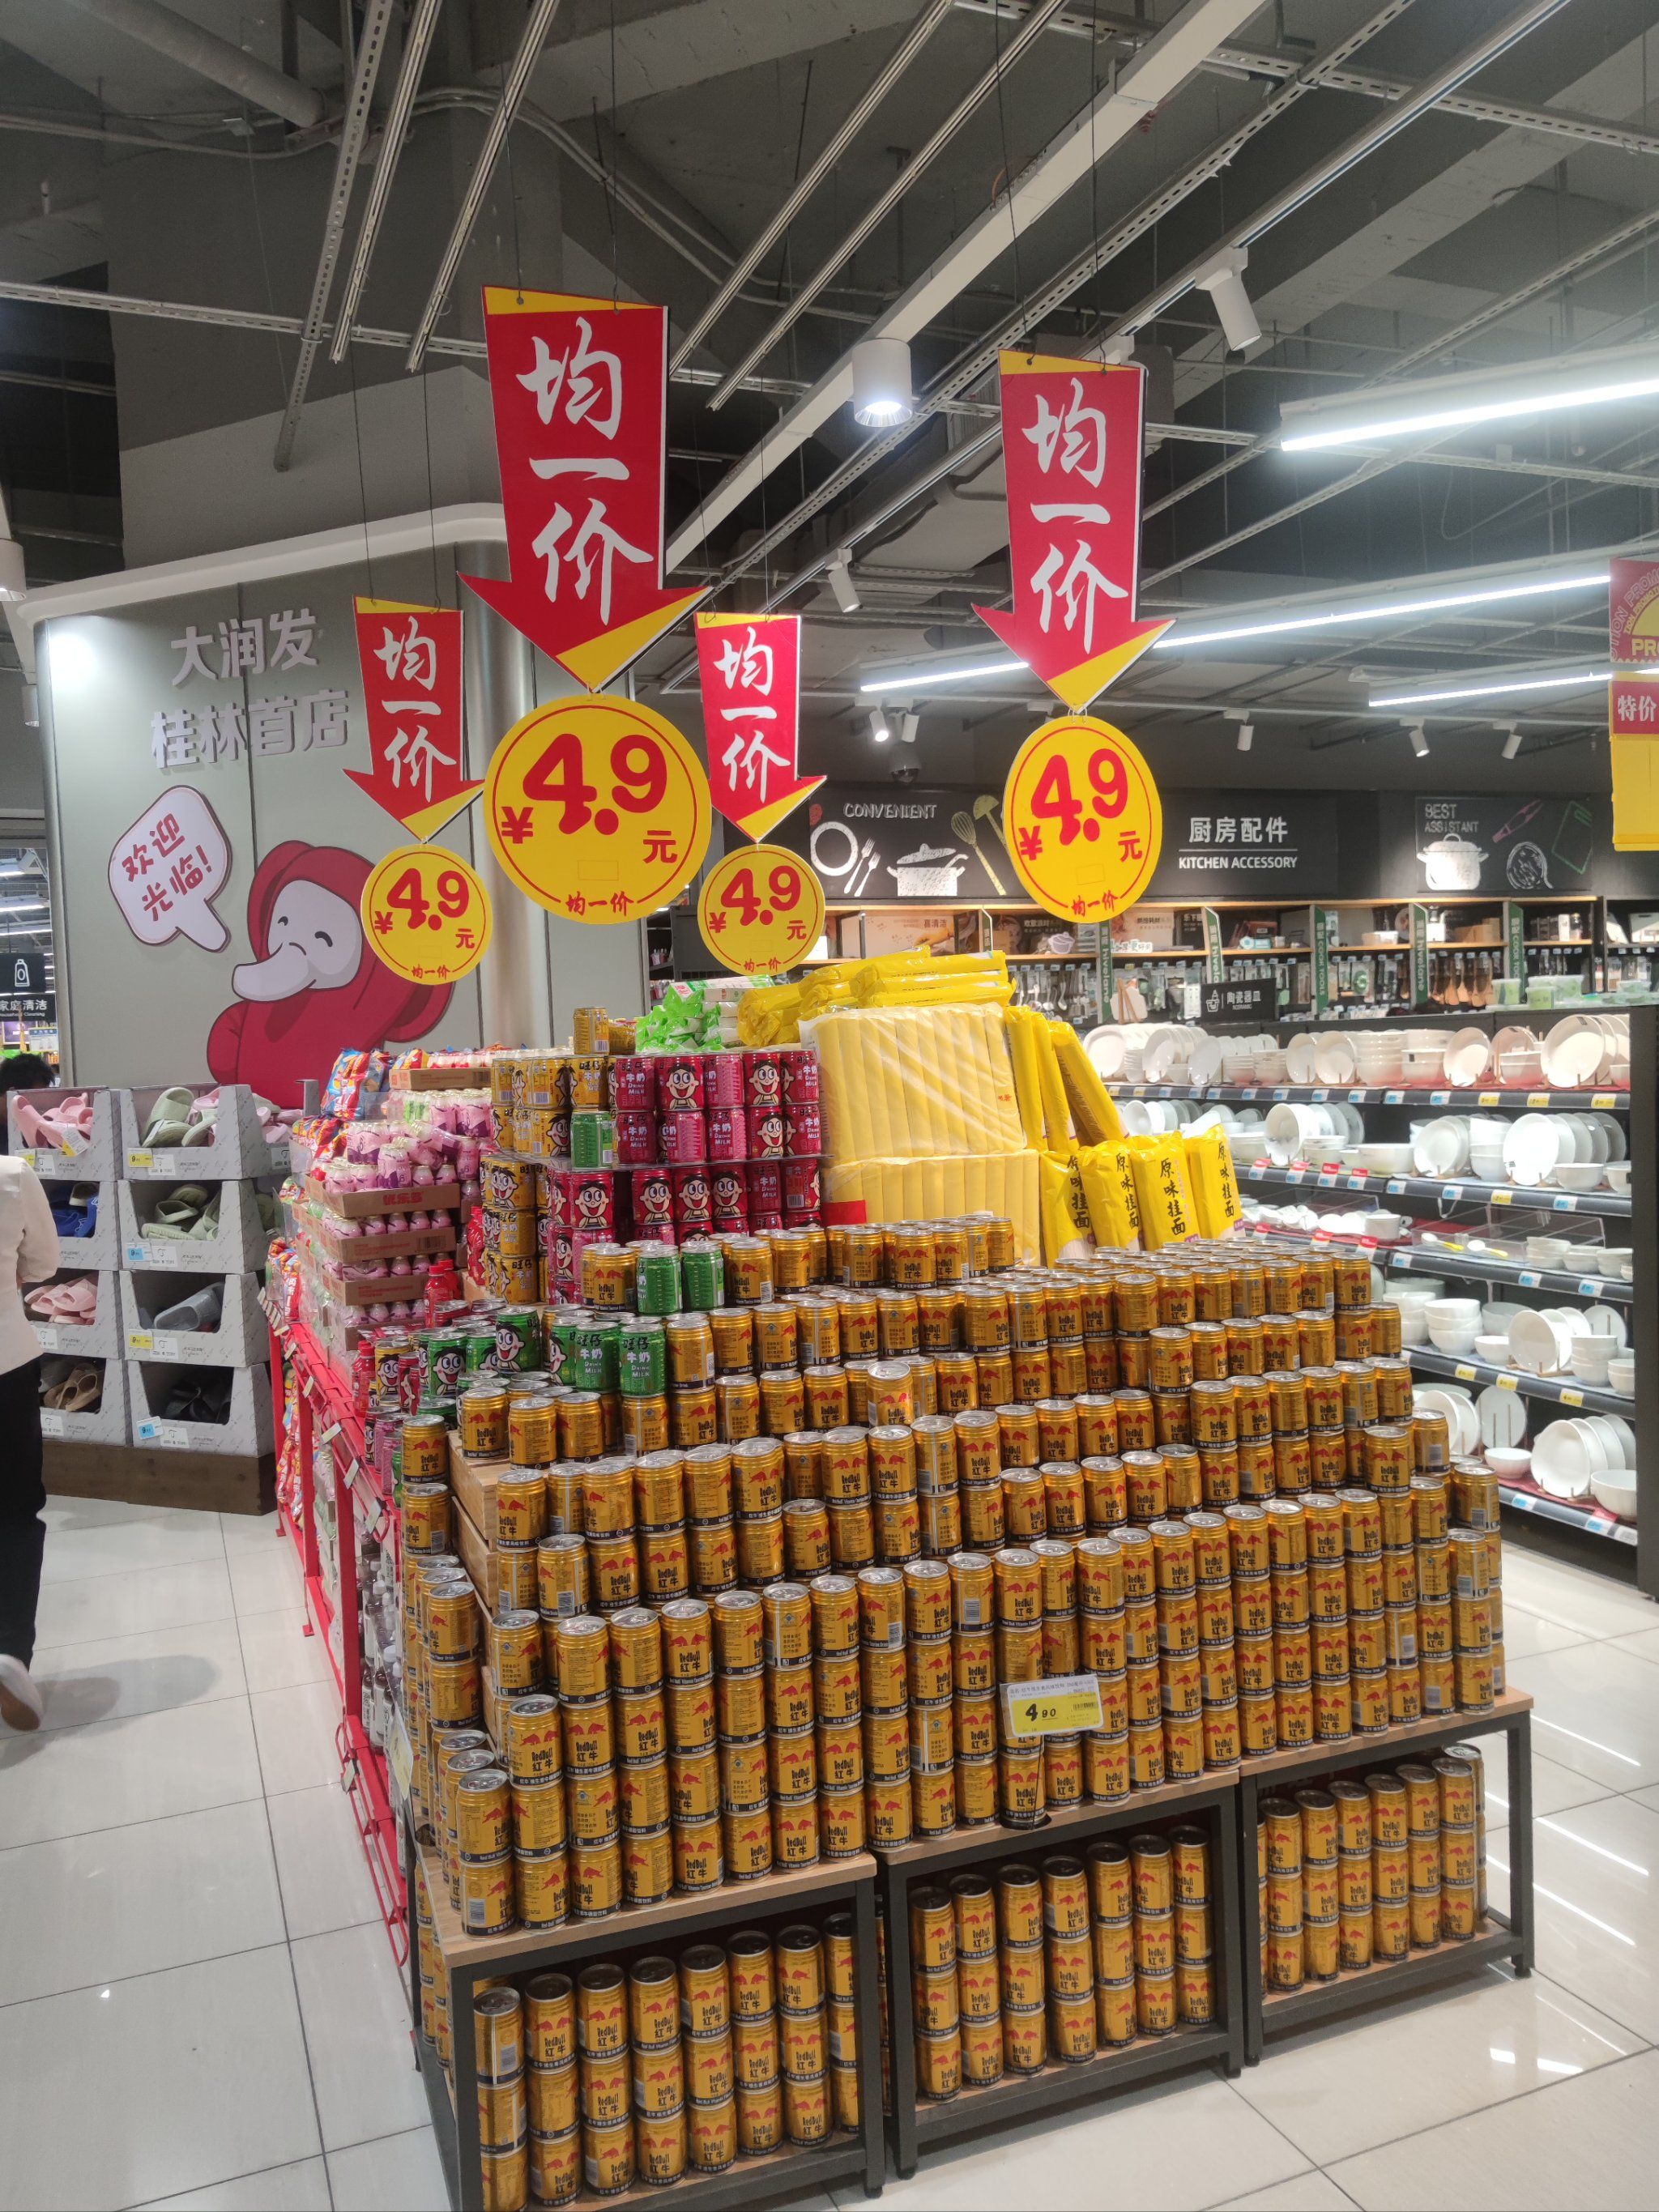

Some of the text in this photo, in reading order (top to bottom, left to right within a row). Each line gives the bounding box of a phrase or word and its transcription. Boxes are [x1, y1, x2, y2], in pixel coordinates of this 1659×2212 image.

[515, 316, 654, 626] 均一价
[1021, 377, 1128, 654] 均一价
[170, 607, 318, 686] 大润发
[1631, 638, 1659, 657] PR
[373, 616, 457, 803] 均一价
[1617, 694, 1657, 722] 特价
[714, 626, 791, 803] 均一价
[151, 689, 348, 768] 桂林首店
[843, 803, 936, 819] CONVENIENT
[1425, 803, 1456, 819] BEST
[1188, 816, 1288, 843] 厨房配件
[1424, 821, 1479, 833] ASSISTANT
[122, 813, 186, 882] 欢迎
[1179, 856, 1298, 869] KITCHEN ACCESSORY
[565, 890, 634, 916] 均一价
[1071, 893, 1120, 918] 均一价
[744, 957, 782, 971] 均一价
[412, 964, 450, 979] 均一价
[0, 999, 47, 1011] 家庭清洁
[626, 1073, 645, 1082] 牛奶
[629, 1127, 646, 1136] 牛奶
[713, 1123, 731, 1132] 牛奶
[760, 1176, 776, 1185] 牛奶
[1218, 1141, 1234, 1218] 原味挂面
[1116, 1153, 1139, 1230] 原味挂面
[1160, 1157, 1186, 1236] 原味挂面
[904, 1263, 920, 1272] RedBull
[1171, 1303, 1188, 1313] RedBull
[1059, 1315, 1075, 1323] RedBull
[578, 1334, 603, 1347] 旺仔
[623, 1337, 649, 1350] 旺仔
[580, 1348, 603, 1360] 牛奶
[627, 1352, 650, 1363] 牛奶
[950, 1390, 968, 1400] RedBull
[1210, 1421, 1228, 1430] RedBull
[477, 1428, 497, 1438] RedBull
[971, 1457, 991, 1468] RedBull
[879, 1468, 898, 1479] RedBull
[1380, 1465, 1400, 1474] RedBull
[842, 1473, 861, 1485] RedBull
[1137, 1494, 1155, 1504] RedBull
[1056, 1505, 1074, 1515] RedBull
[1317, 1537, 1335, 1546] RedBull
[1205, 1556, 1223, 1566] RedBull
[657, 1567, 678, 1579] RedBull
[611, 1574, 631, 1586] RedBull
[1015, 1597, 1034, 1608] RedBull
[1427, 1631, 1444, 1640] RedBull
[1286, 1661, 1303, 1670] RedBull
[1320, 1712, 1340, 1722] RedBull
[576, 1741, 598, 1752] RedBull
[1215, 1738, 1233, 1747] RedBull
[531, 1748, 552, 1761] RedBull
[834, 1758, 854, 1770] RedBull
[1057, 1776, 1076, 1788] RedBull
[1383, 1822, 1400, 1831] RedBull
[686, 1859, 707, 1870] RedBull
[1060, 1973, 1078, 1982] RedBull
[740, 1990, 761, 2001] RedBull
[545, 2037, 566, 2048] RedBull
